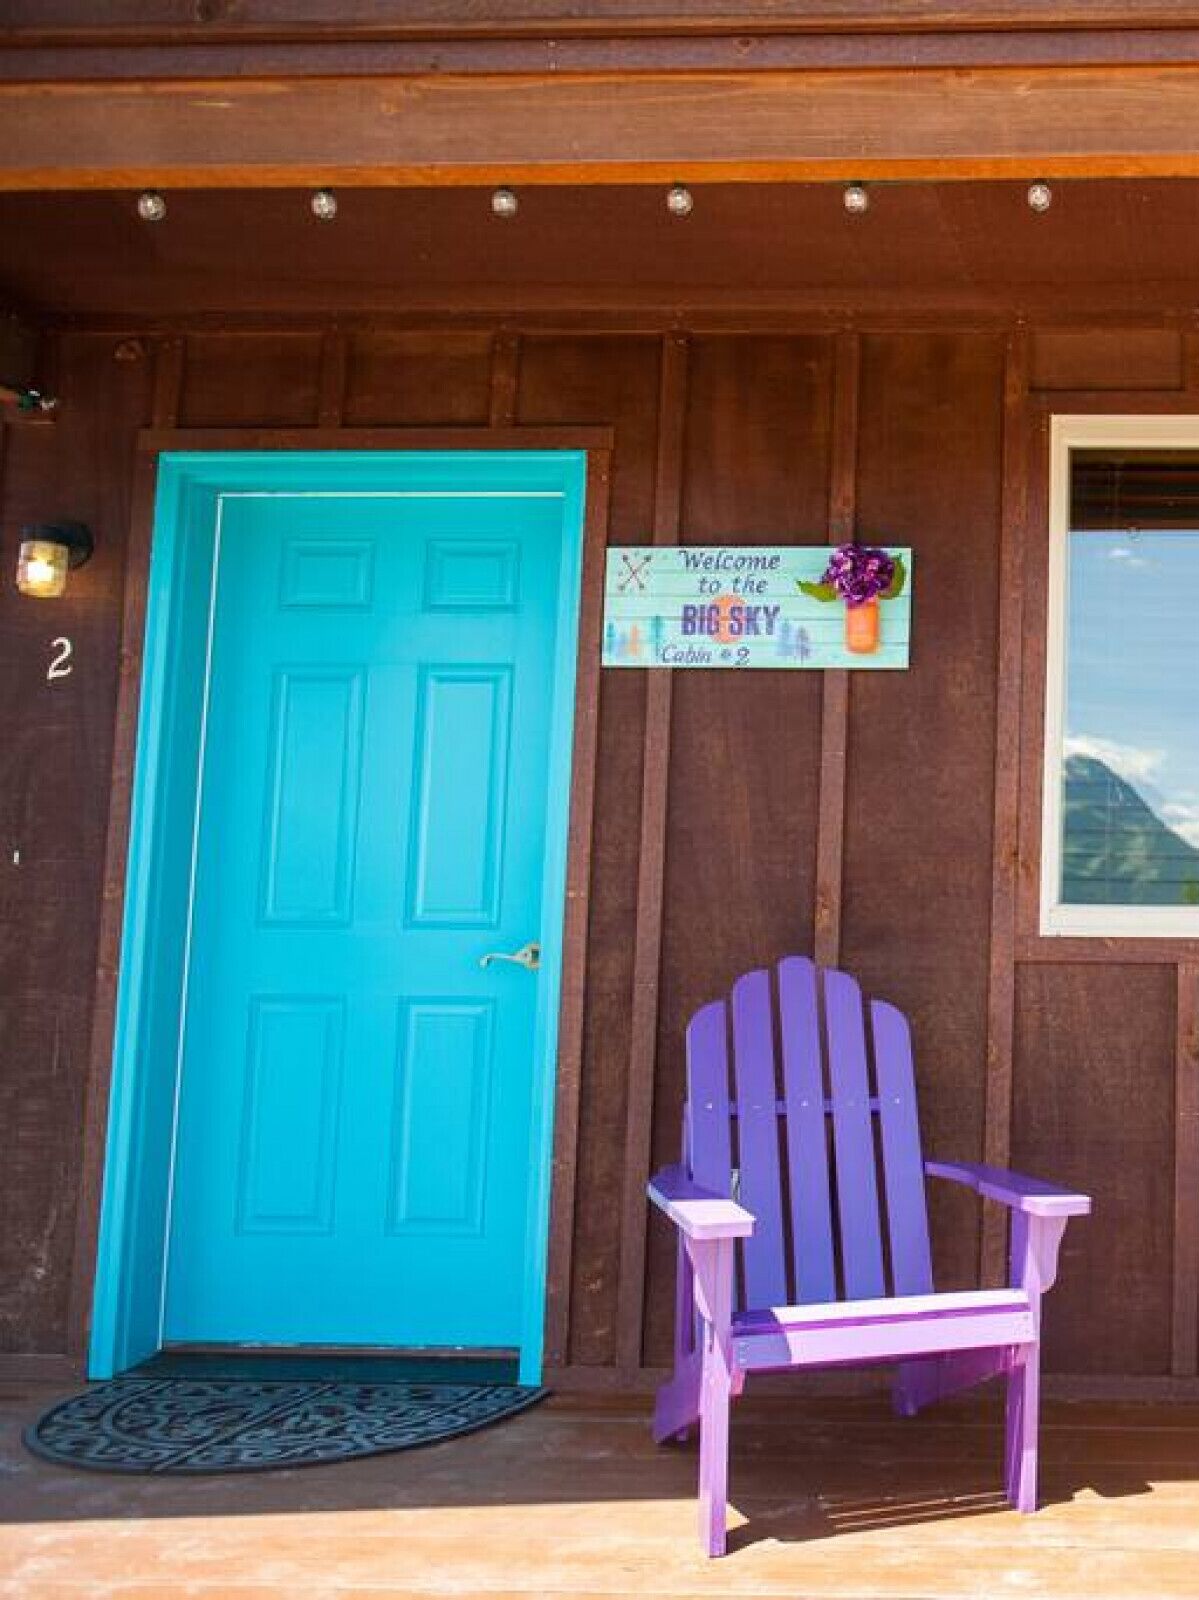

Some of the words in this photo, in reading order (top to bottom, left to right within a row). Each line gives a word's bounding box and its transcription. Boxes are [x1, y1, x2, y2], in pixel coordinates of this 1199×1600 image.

[678, 549, 781, 571] Welcome
[699, 577, 722, 594] to
[732, 573, 768, 594] the
[682, 604, 720, 636] BIG
[729, 605, 781, 636] SKY
[47, 636, 73, 680] 2
[662, 643, 713, 664] Cabin
